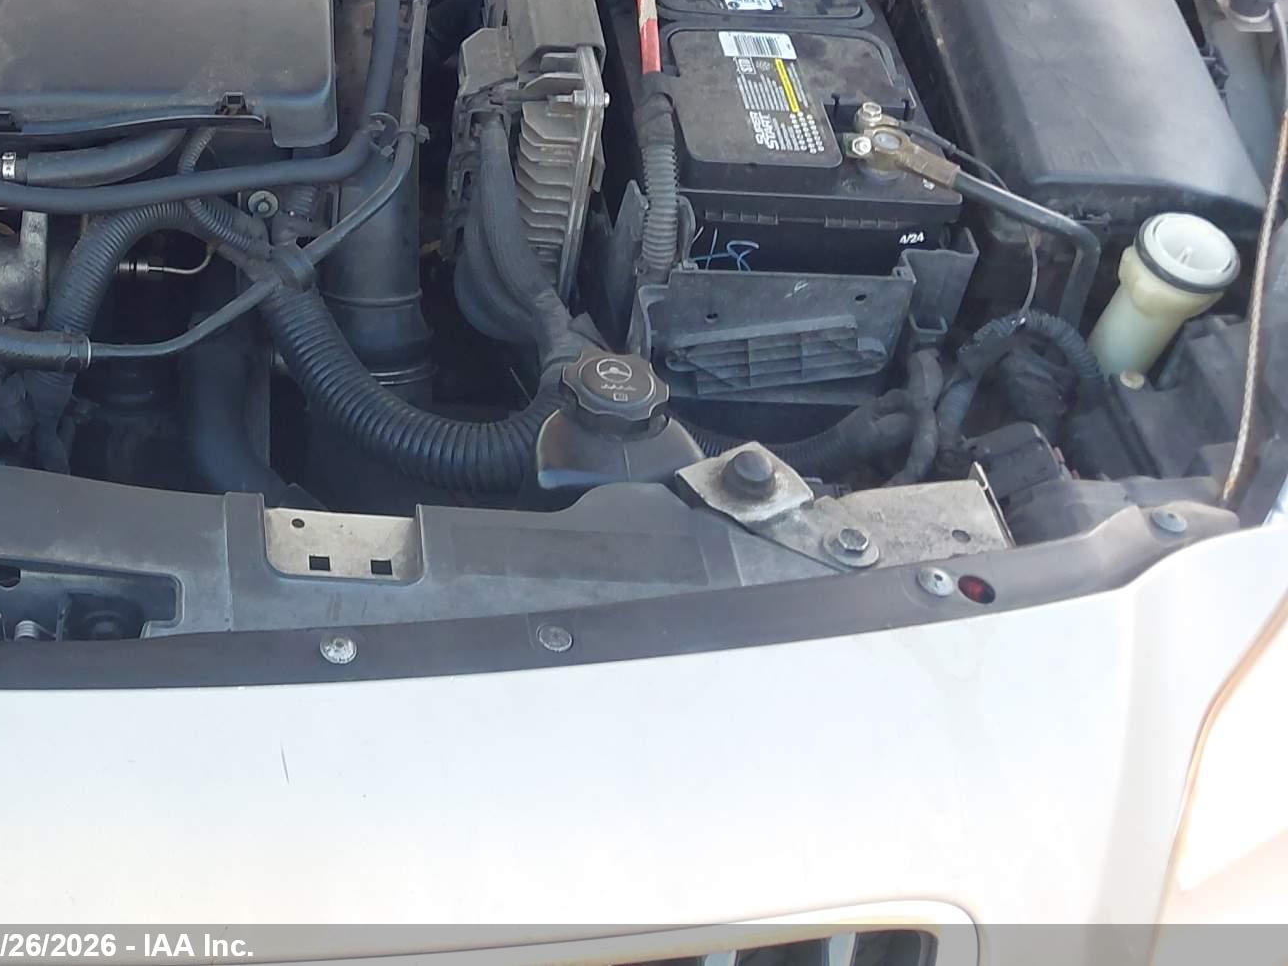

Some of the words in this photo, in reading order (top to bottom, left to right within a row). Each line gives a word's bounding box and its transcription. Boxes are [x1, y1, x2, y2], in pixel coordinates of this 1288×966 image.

[749, 111, 767, 144] SUPER
[759, 111, 780, 151] START
[899, 231, 924, 244] 4/24
